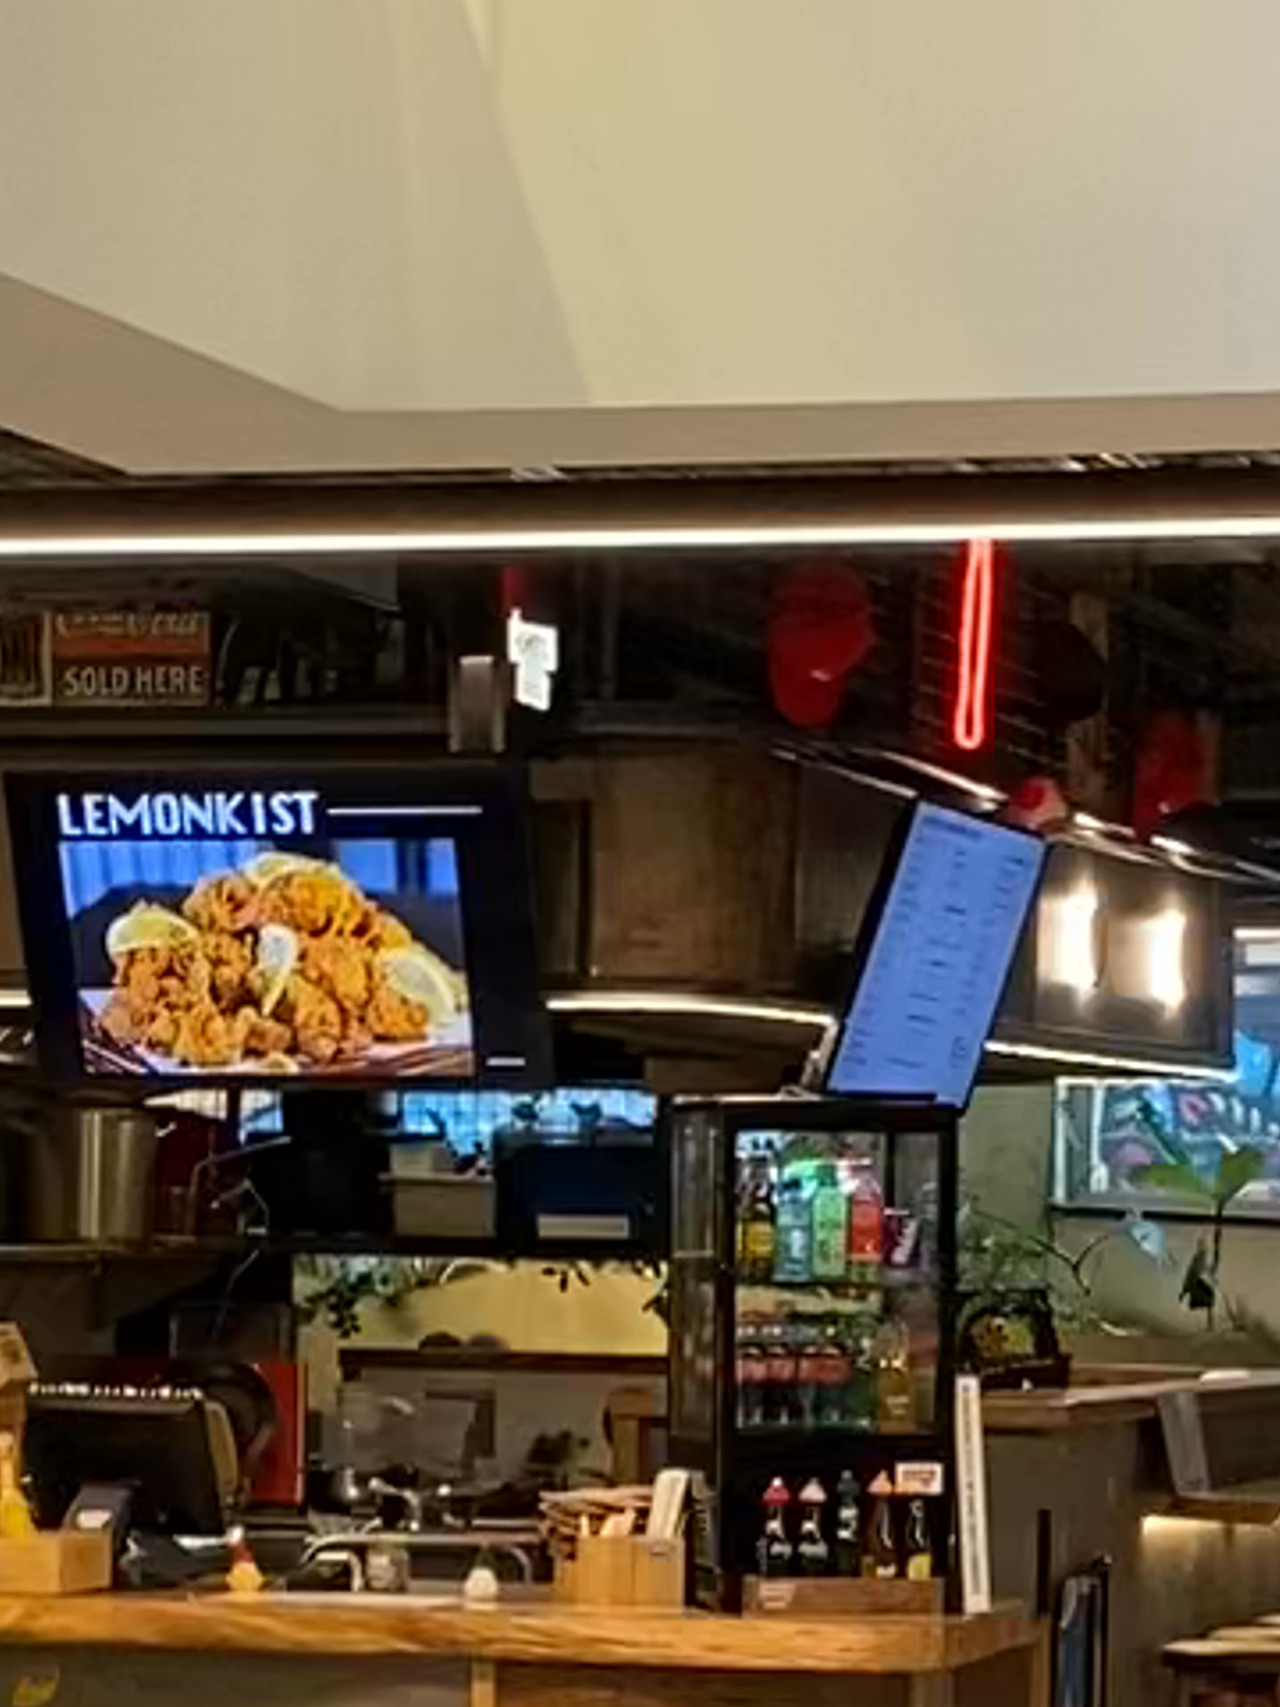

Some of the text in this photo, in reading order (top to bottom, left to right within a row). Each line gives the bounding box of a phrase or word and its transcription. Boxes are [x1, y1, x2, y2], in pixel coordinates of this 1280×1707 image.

[64, 664, 203, 697] SOLD HERE
[57, 791, 318, 835] LEMONKIST
